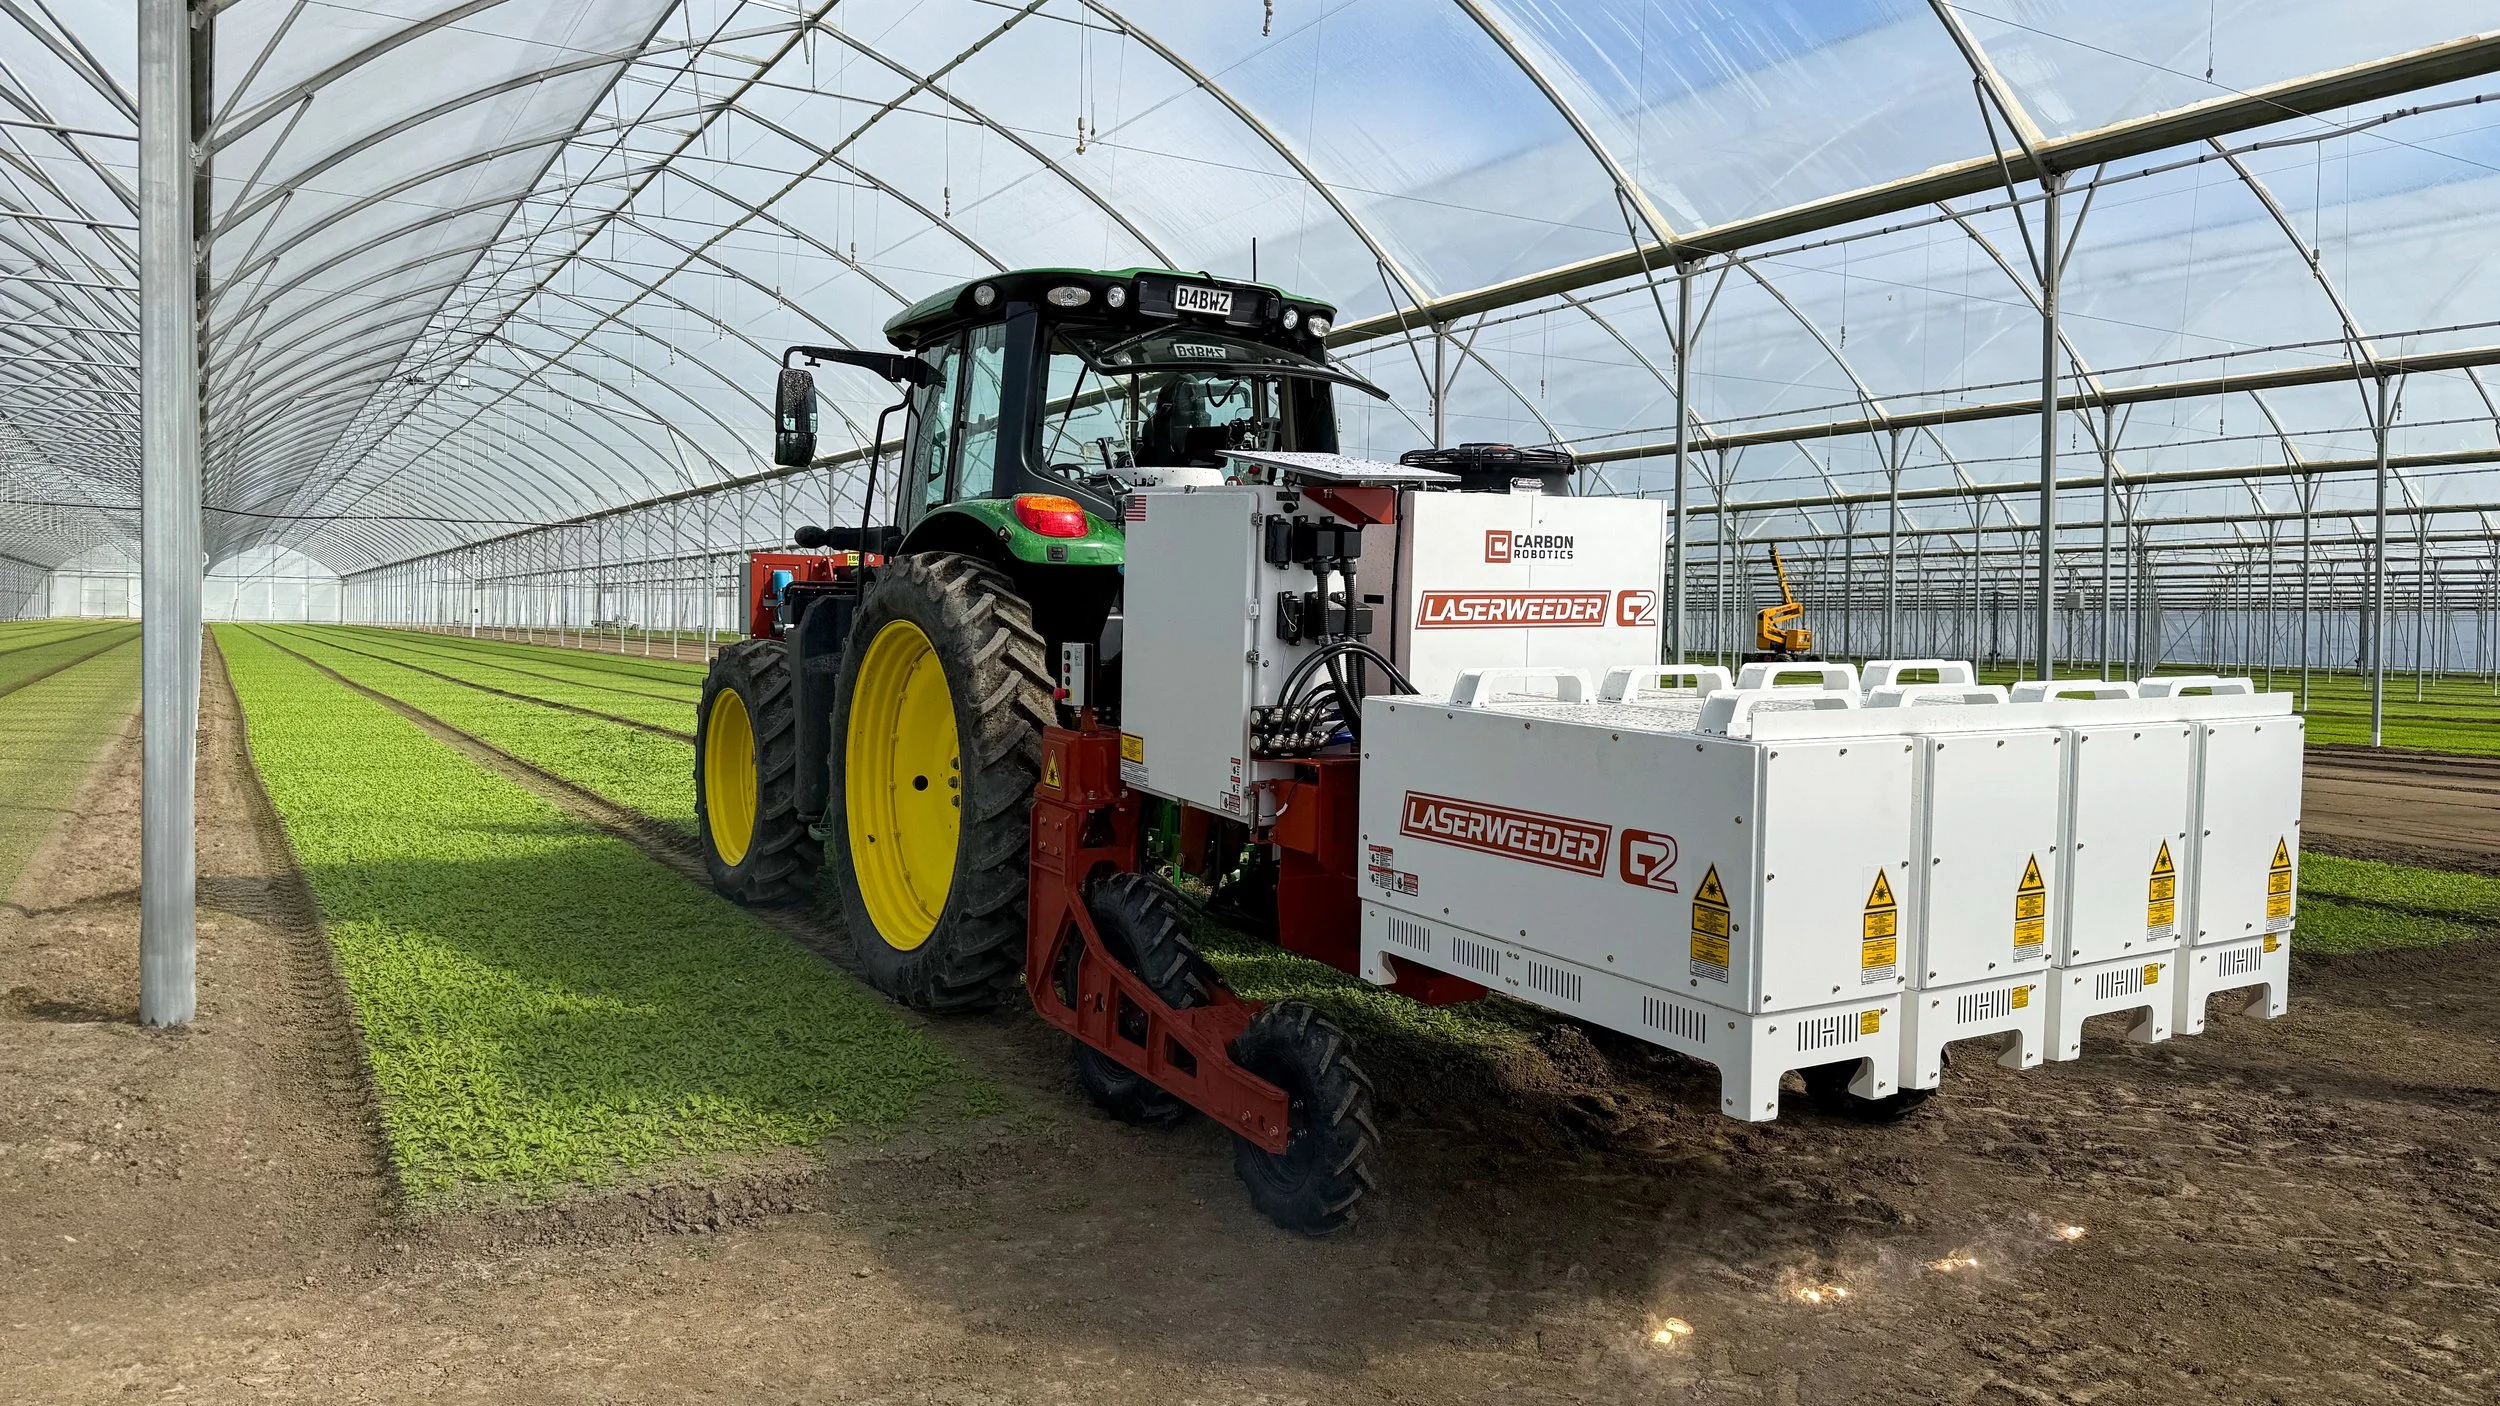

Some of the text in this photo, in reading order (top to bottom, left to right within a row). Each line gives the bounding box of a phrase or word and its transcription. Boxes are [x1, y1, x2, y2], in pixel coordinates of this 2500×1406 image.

[1178, 288, 1230, 312] D4BWZ
[1514, 534, 1574, 549] CARBON
[1514, 549, 1574, 560] ROBOTICS
[1425, 589, 1657, 628] LASERWEEDER G2
[1408, 801, 1679, 894] LASERWEEDER G2
